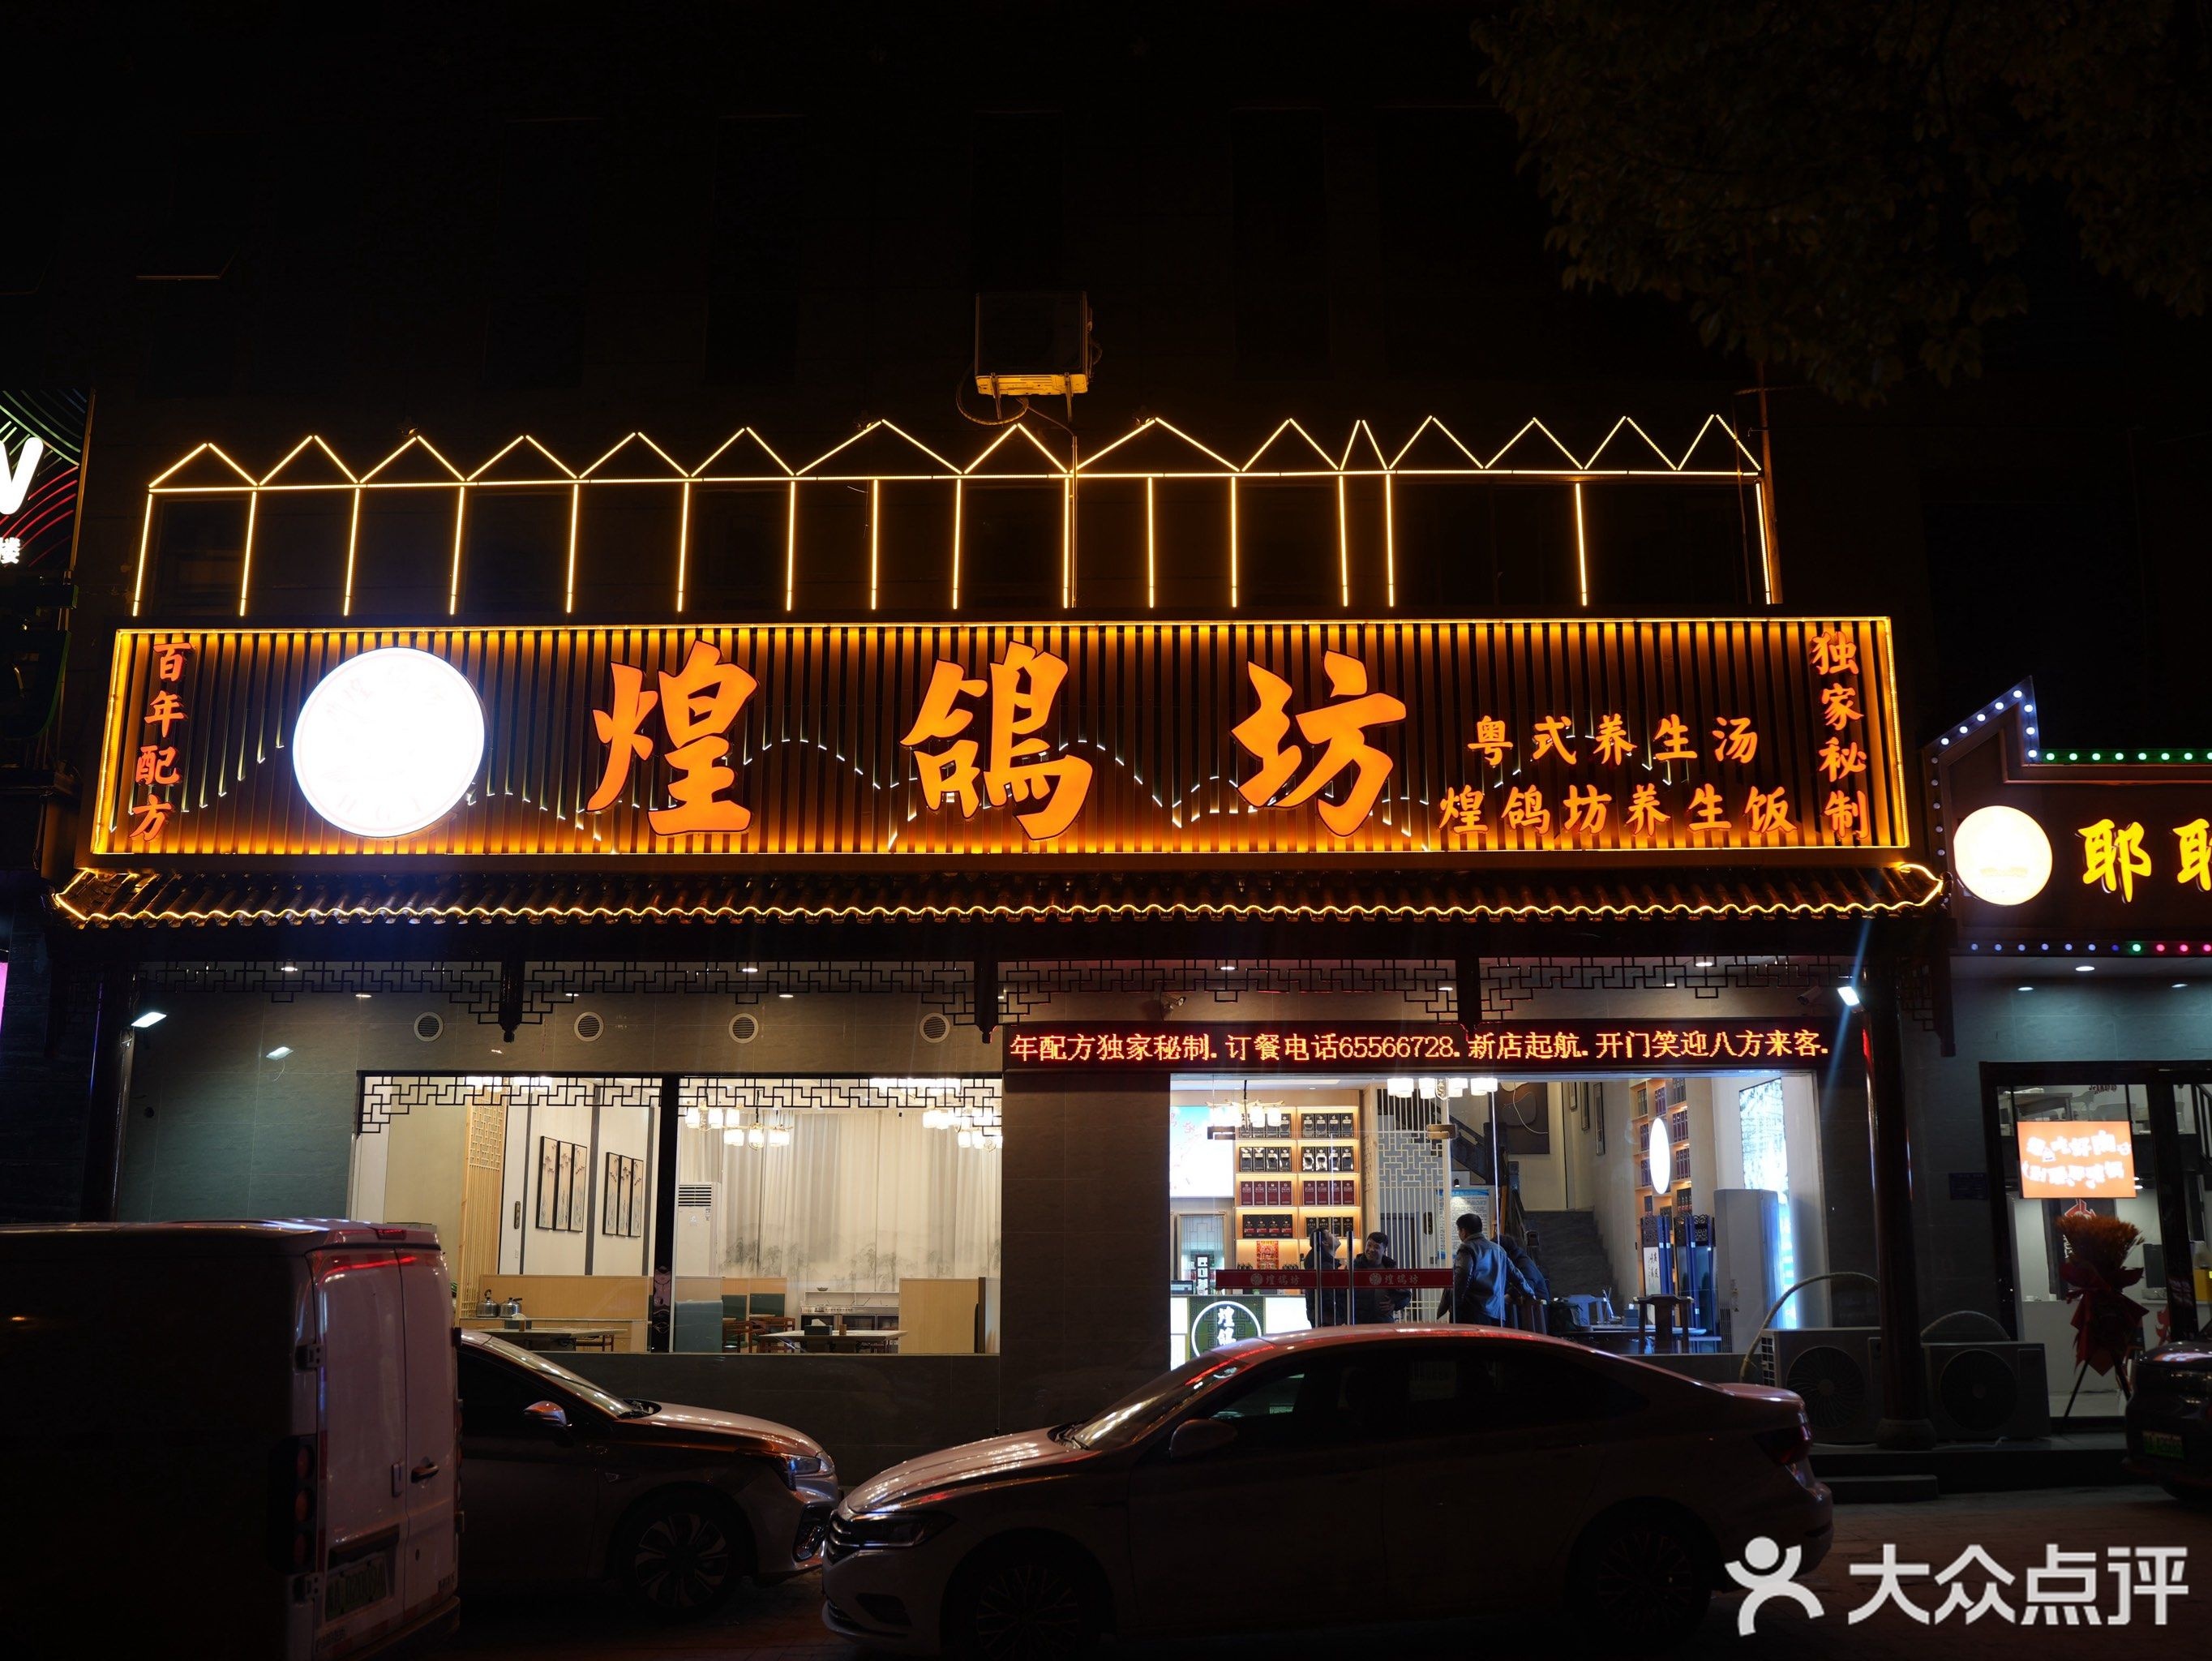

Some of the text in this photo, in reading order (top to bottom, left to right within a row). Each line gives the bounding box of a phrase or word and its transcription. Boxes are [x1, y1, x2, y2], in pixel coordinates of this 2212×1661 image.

[129, 642, 195, 842] 百年配方
[587, 641, 1407, 840] 煌鸽坊
[1438, 783, 1798, 836] 煌鸽坊养生饭
[1467, 714, 1759, 766] 粤式养生汤
[1811, 631, 1869, 839] 独家秘制
